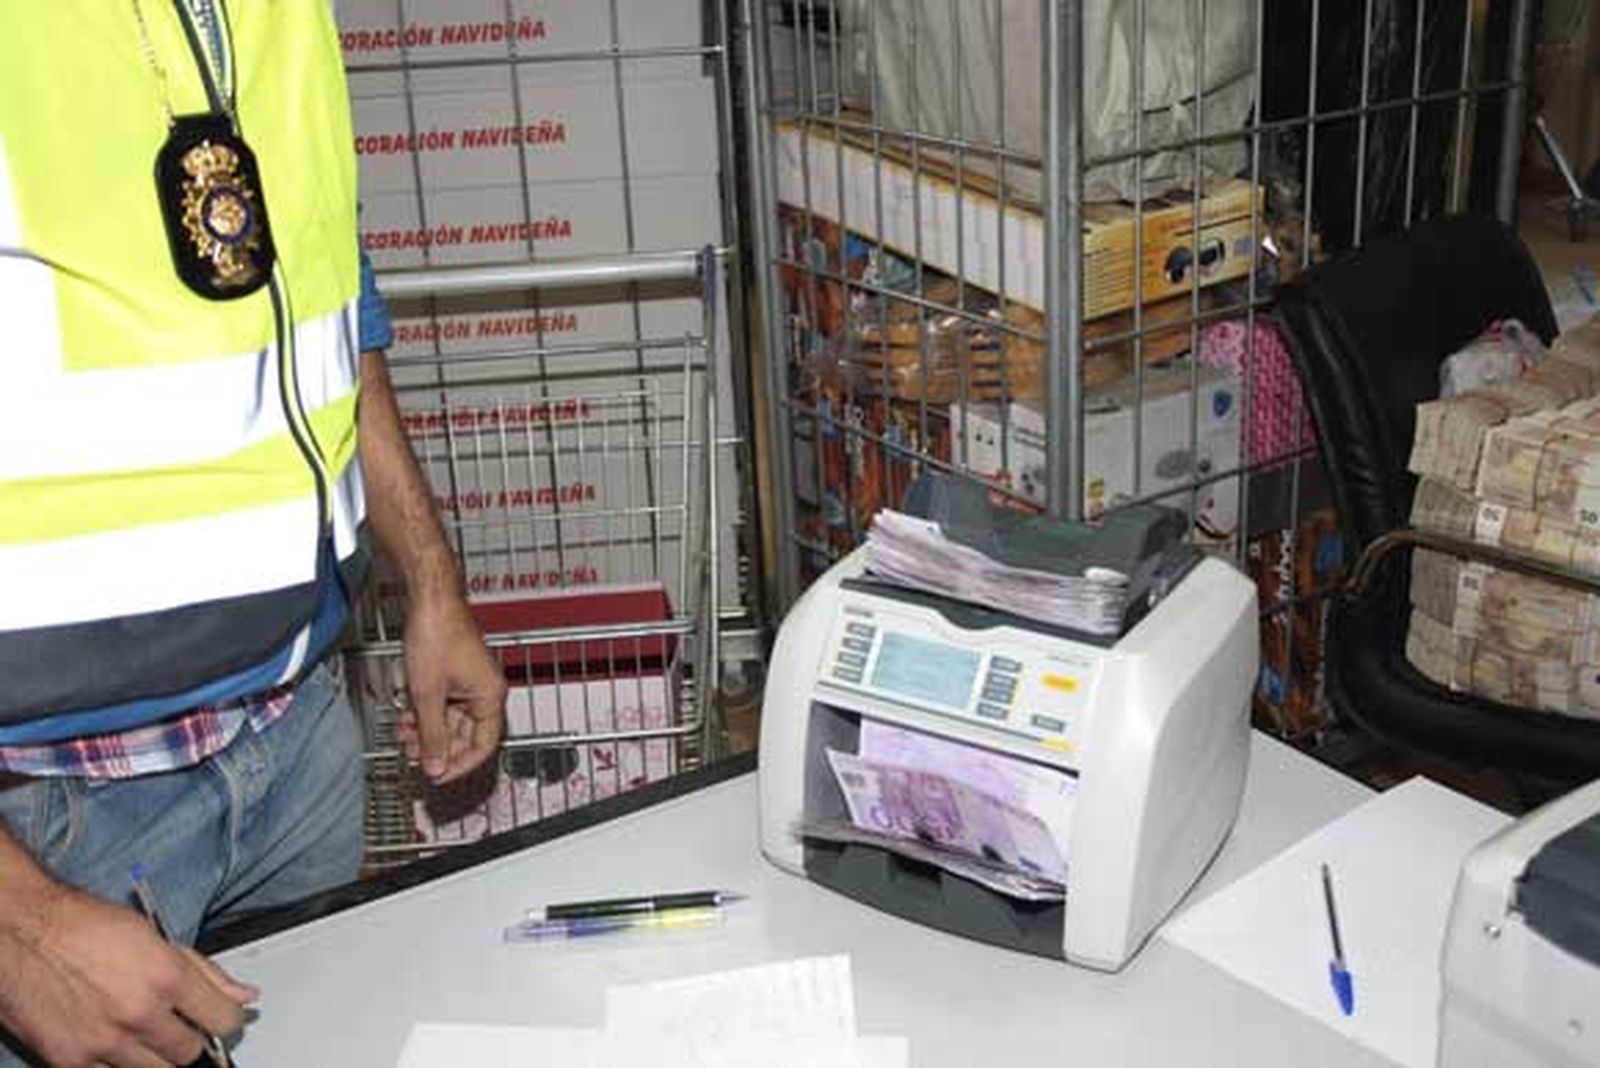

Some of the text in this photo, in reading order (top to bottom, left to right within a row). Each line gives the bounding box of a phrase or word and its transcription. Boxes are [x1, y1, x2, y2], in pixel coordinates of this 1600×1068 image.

[441, 17, 545, 44] NAVIDEÑA
[354, 121, 565, 155] CORACIÓN NAVIDEÑA
[365, 218, 571, 250] CORACIÓN NAVIDEÑA
[477, 313, 576, 337] NAVIDEÑA
